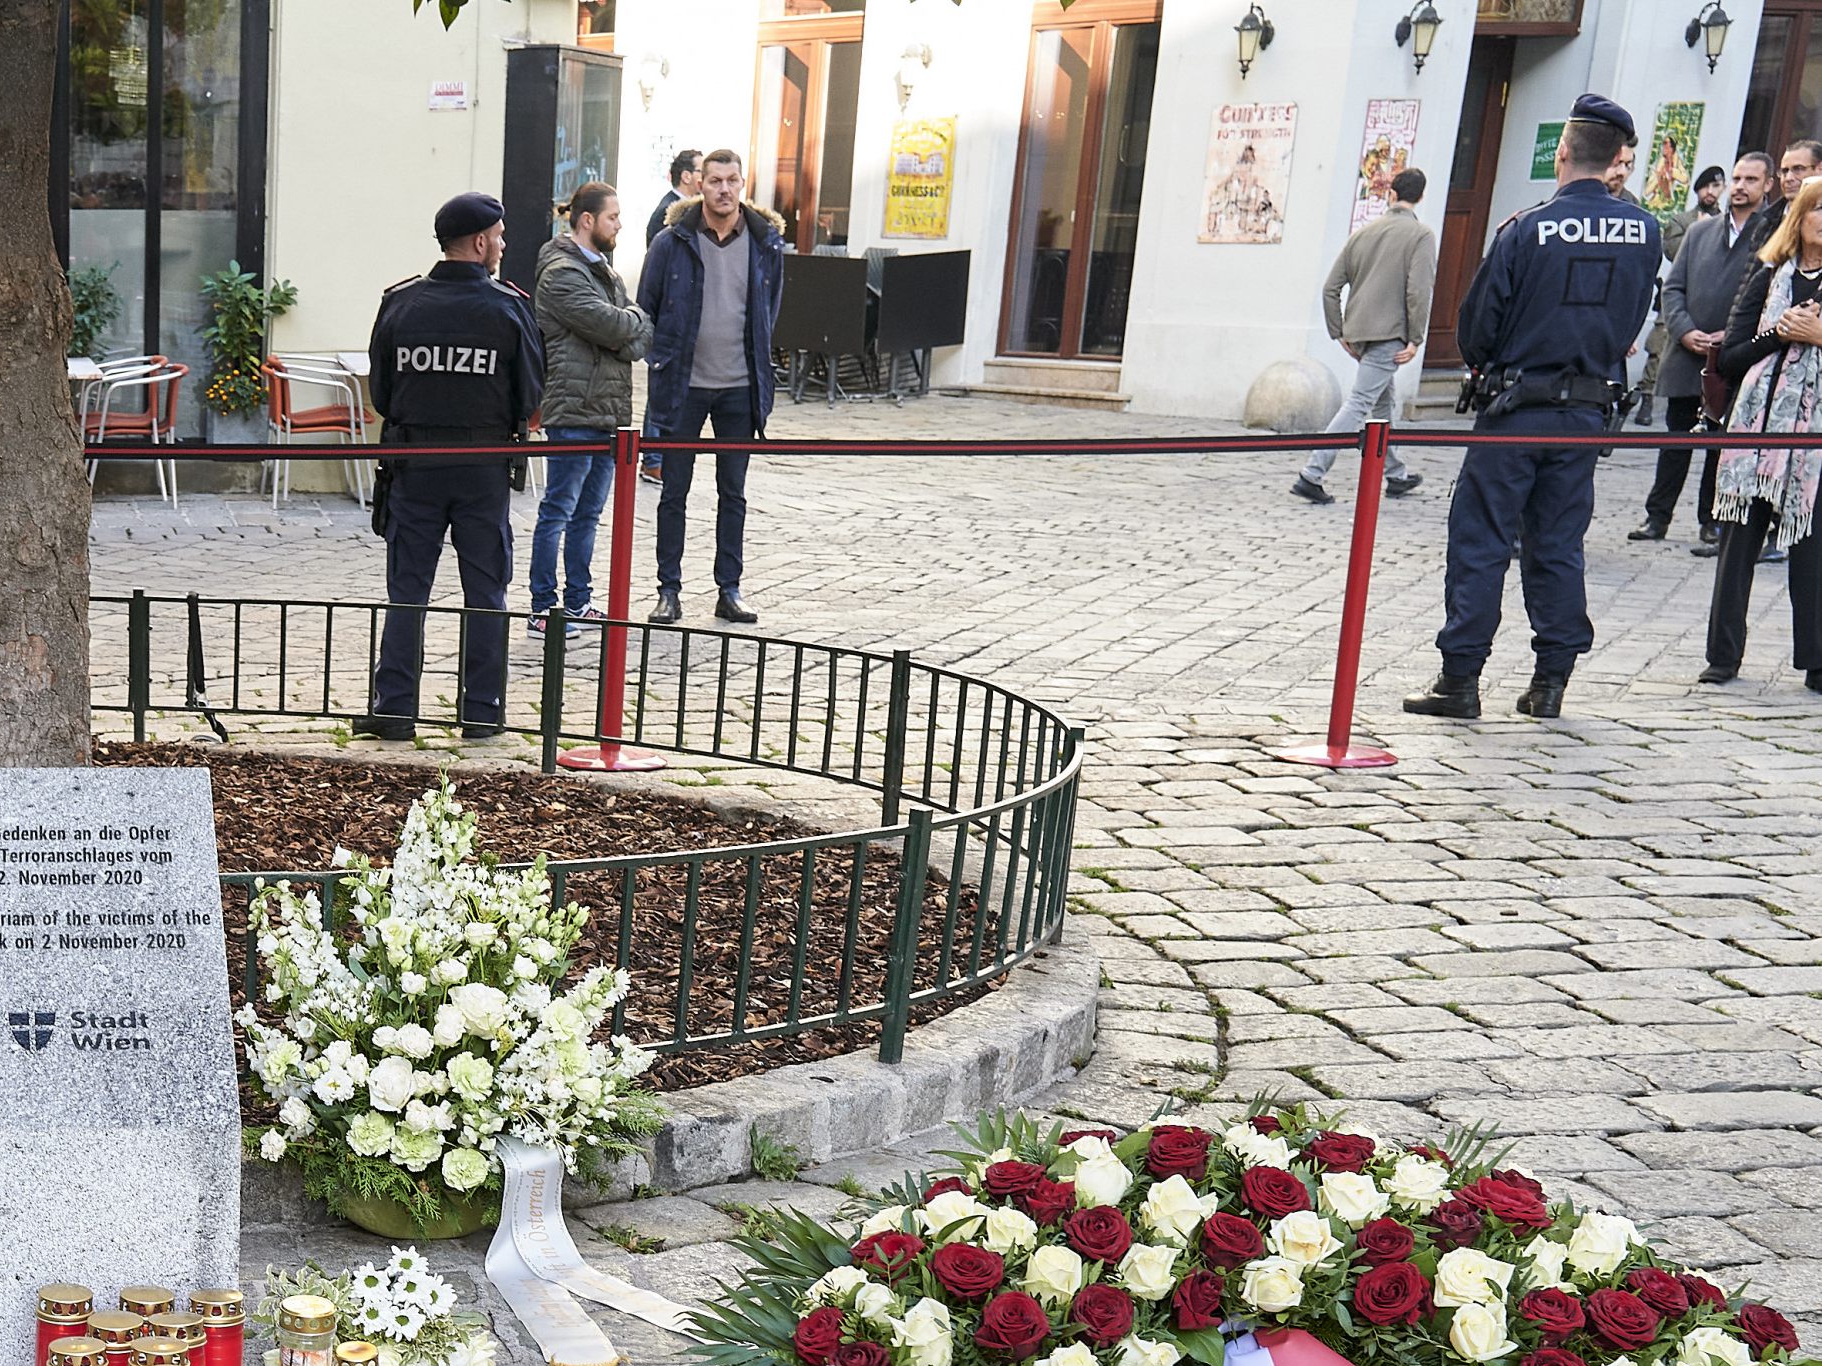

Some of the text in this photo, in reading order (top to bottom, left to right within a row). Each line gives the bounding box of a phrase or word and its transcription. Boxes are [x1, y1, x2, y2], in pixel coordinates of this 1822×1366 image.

[1538, 217, 1646, 246] POLIZEI
[397, 346, 497, 375] POLIZEI
[74, 829, 92, 841] an
[99, 825, 121, 841] die
[129, 826, 171, 845] Opfer
[0, 848, 133, 867] Terroranschlages
[140, 852, 173, 863] vom
[19, 870, 97, 885] November
[104, 870, 143, 885] 2020
[43, 909, 60, 926] of
[66, 910, 91, 926] the
[98, 910, 155, 926] victims
[162, 909, 179, 926] of
[185, 910, 212, 926] the
[15, 936, 34, 949] on
[42, 933, 52, 949] 2
[59, 933, 138, 949] November
[147, 933, 186, 949] 2020
[70, 1010, 149, 1030] Stadt
[71, 1031, 152, 1051] Wien
[523, 1169, 549, 1242] Österreich
